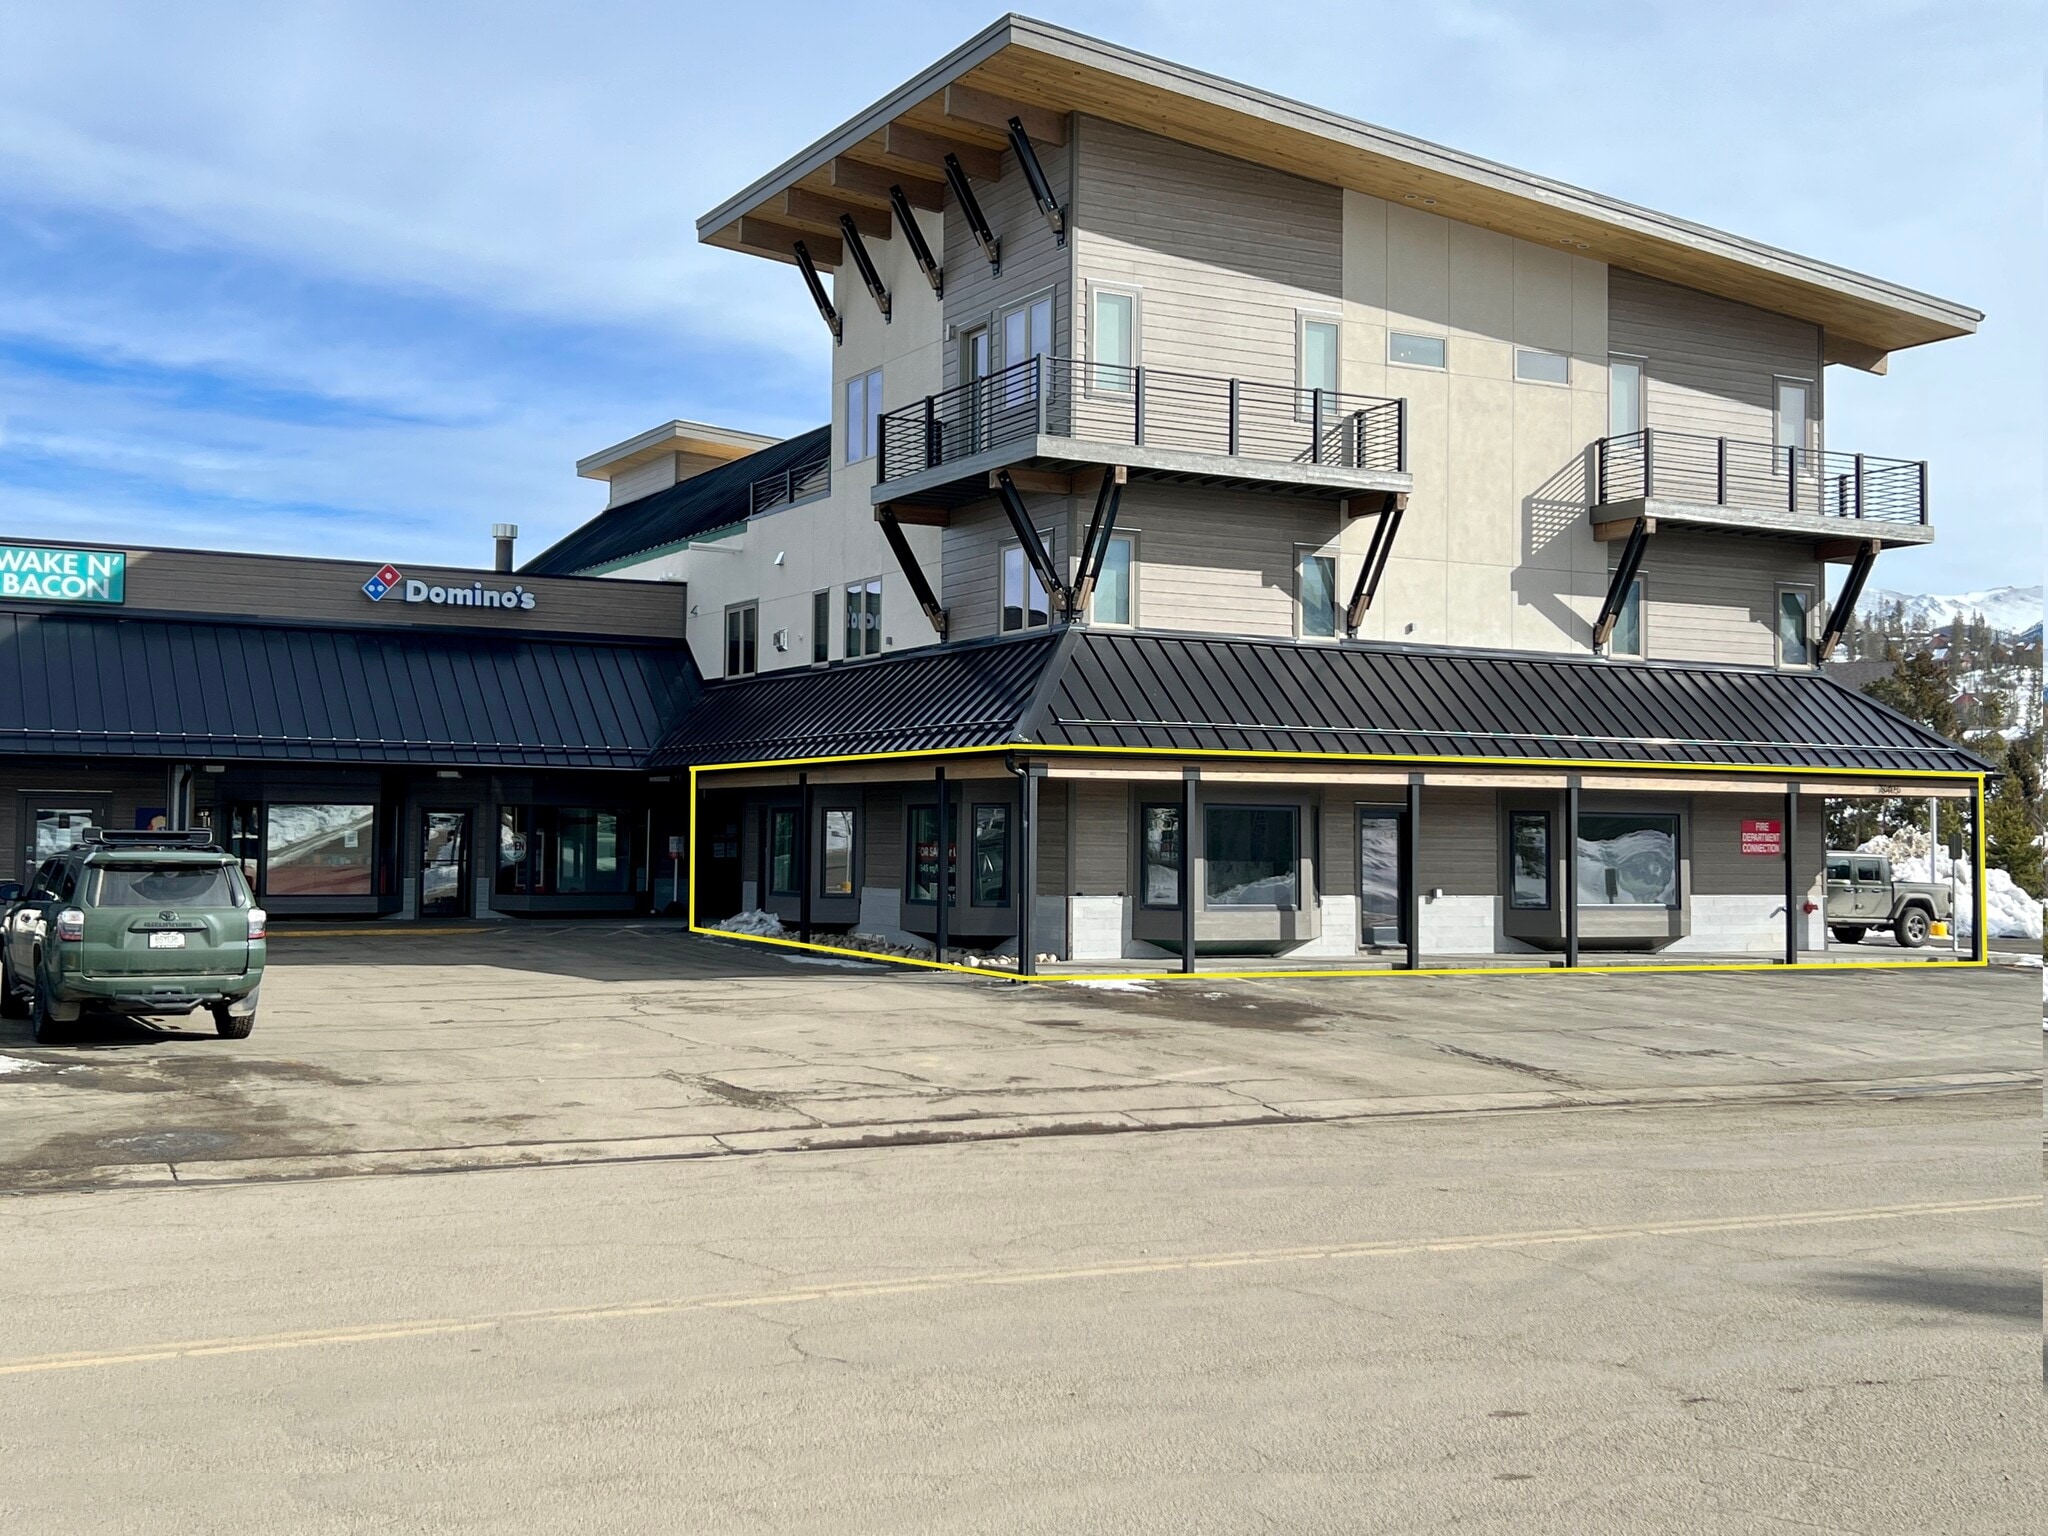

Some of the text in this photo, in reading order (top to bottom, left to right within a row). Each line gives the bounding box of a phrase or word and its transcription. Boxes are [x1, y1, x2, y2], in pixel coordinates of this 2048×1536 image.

[0, 550, 120, 578] WAKE N'
[3, 573, 110, 599] BACON
[405, 579, 536, 610] Domino's
[1755, 822, 1770, 832] FIRE
[1742, 832, 1781, 842] DEPARTMENT
[1742, 843, 1780, 853] CONNECTION
